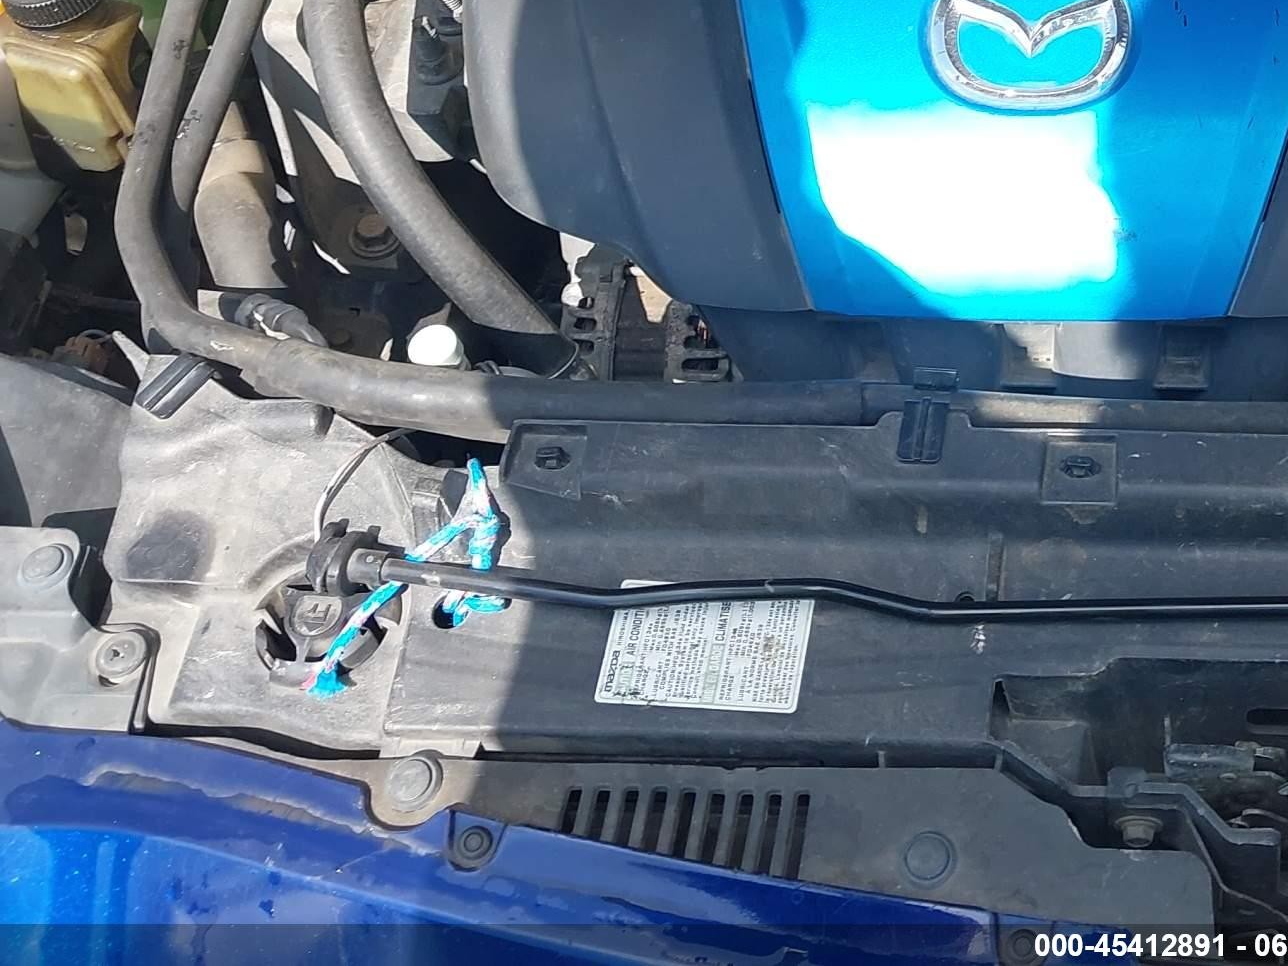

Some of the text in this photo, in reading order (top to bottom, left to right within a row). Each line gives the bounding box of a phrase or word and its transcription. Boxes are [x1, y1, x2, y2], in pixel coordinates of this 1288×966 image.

[626, 608, 645, 655] AIR CONDITI
[604, 650, 620, 692] mazda
